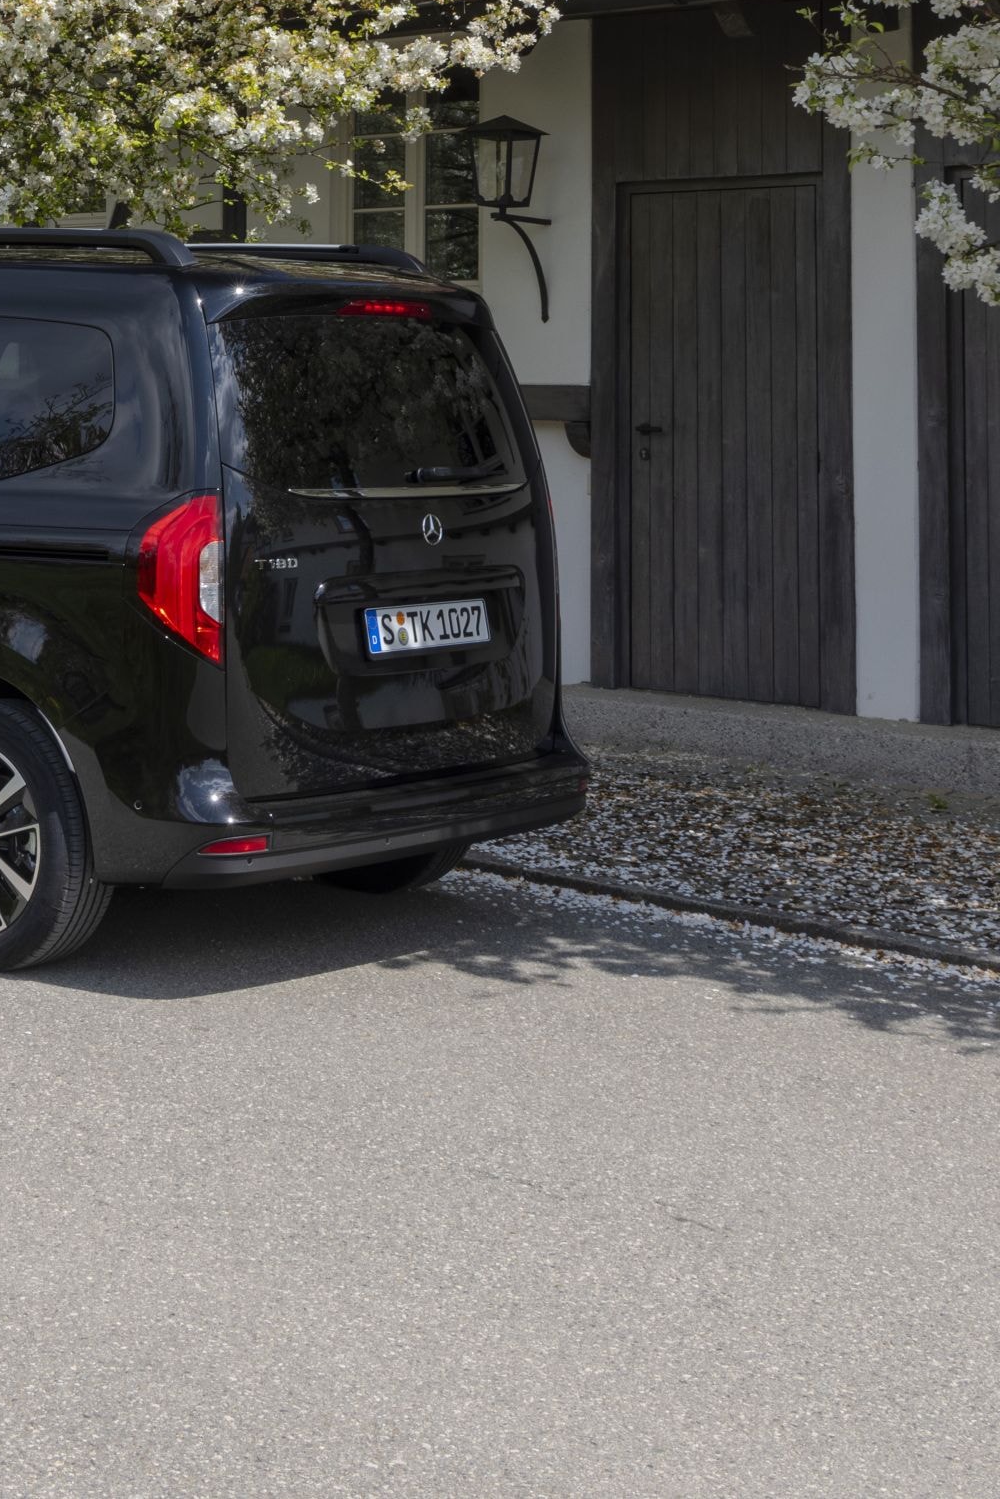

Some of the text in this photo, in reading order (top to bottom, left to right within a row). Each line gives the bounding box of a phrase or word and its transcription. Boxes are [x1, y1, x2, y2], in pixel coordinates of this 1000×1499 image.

[381, 613, 395, 645] S
[437, 605, 482, 640] 1027
[371, 635, 378, 645] D
